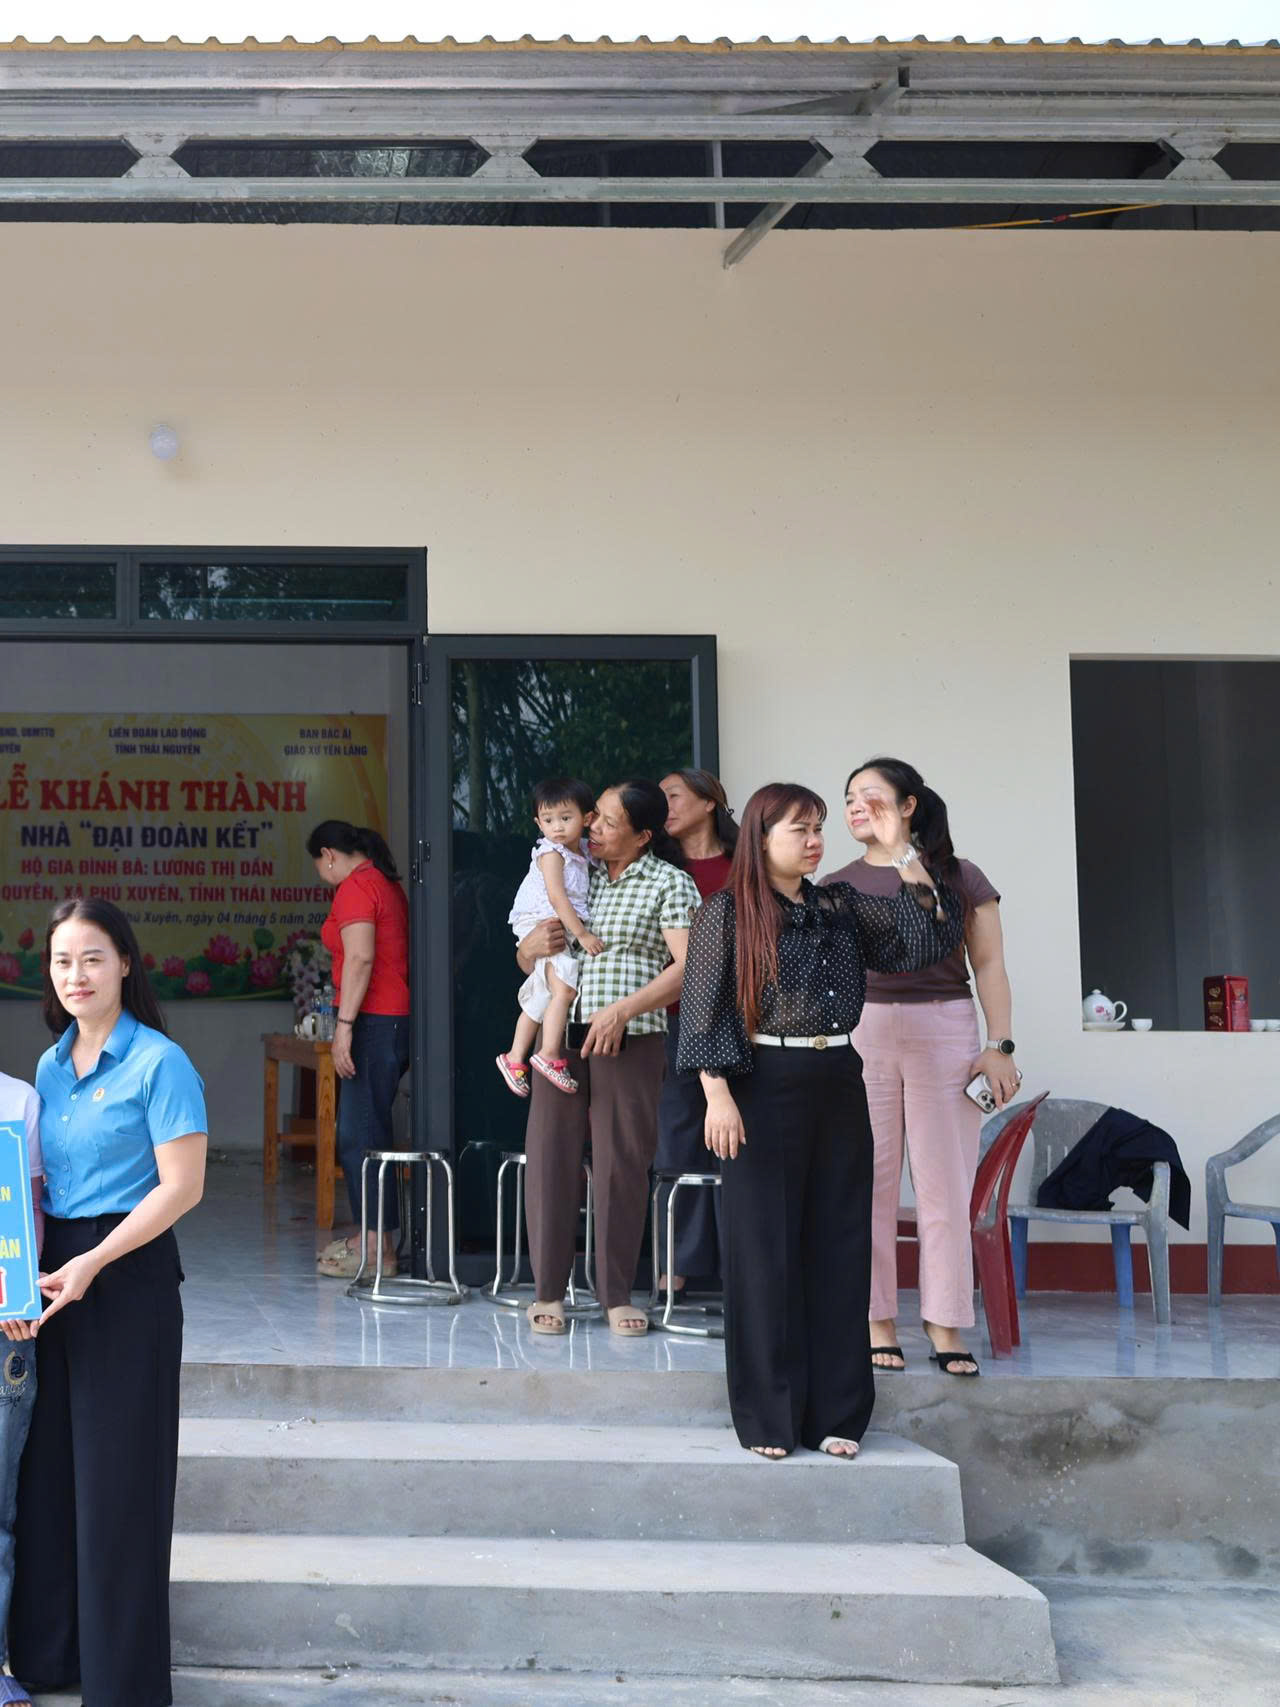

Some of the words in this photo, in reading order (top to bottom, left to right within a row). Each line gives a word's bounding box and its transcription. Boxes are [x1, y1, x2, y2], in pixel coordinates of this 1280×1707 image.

[160, 728, 178, 738] LAO
[299, 728, 319, 739] BAN
[39, 771, 170, 812] KHÁNH
[180, 772, 307, 812] THÀNH
[21, 821, 70, 848] NHÀ
[141, 821, 208, 849] ĐOÀN
[21, 856, 42, 878] HỘ
[48, 859, 73, 875] GIA
[79, 856, 117, 876] ĐÌNH
[122, 856, 148, 876] BÀ:
[153, 858, 206, 876] LƯƠNG
[210, 859, 236, 879] THỊ
[90, 883, 120, 901] PHÚ
[127, 882, 184, 903] XUYÊN,
[189, 881, 225, 901] TỈNH
[230, 884, 265, 902] THÁI
[271, 883, 336, 902] NGUYÊN
[123, 911, 141, 923] hú
[185, 911, 215, 927] ngày
[217, 911, 230, 924] 04
[233, 912, 266, 927] tháng
[280, 912, 304, 924] năm
[307, 911, 328, 924] 202
